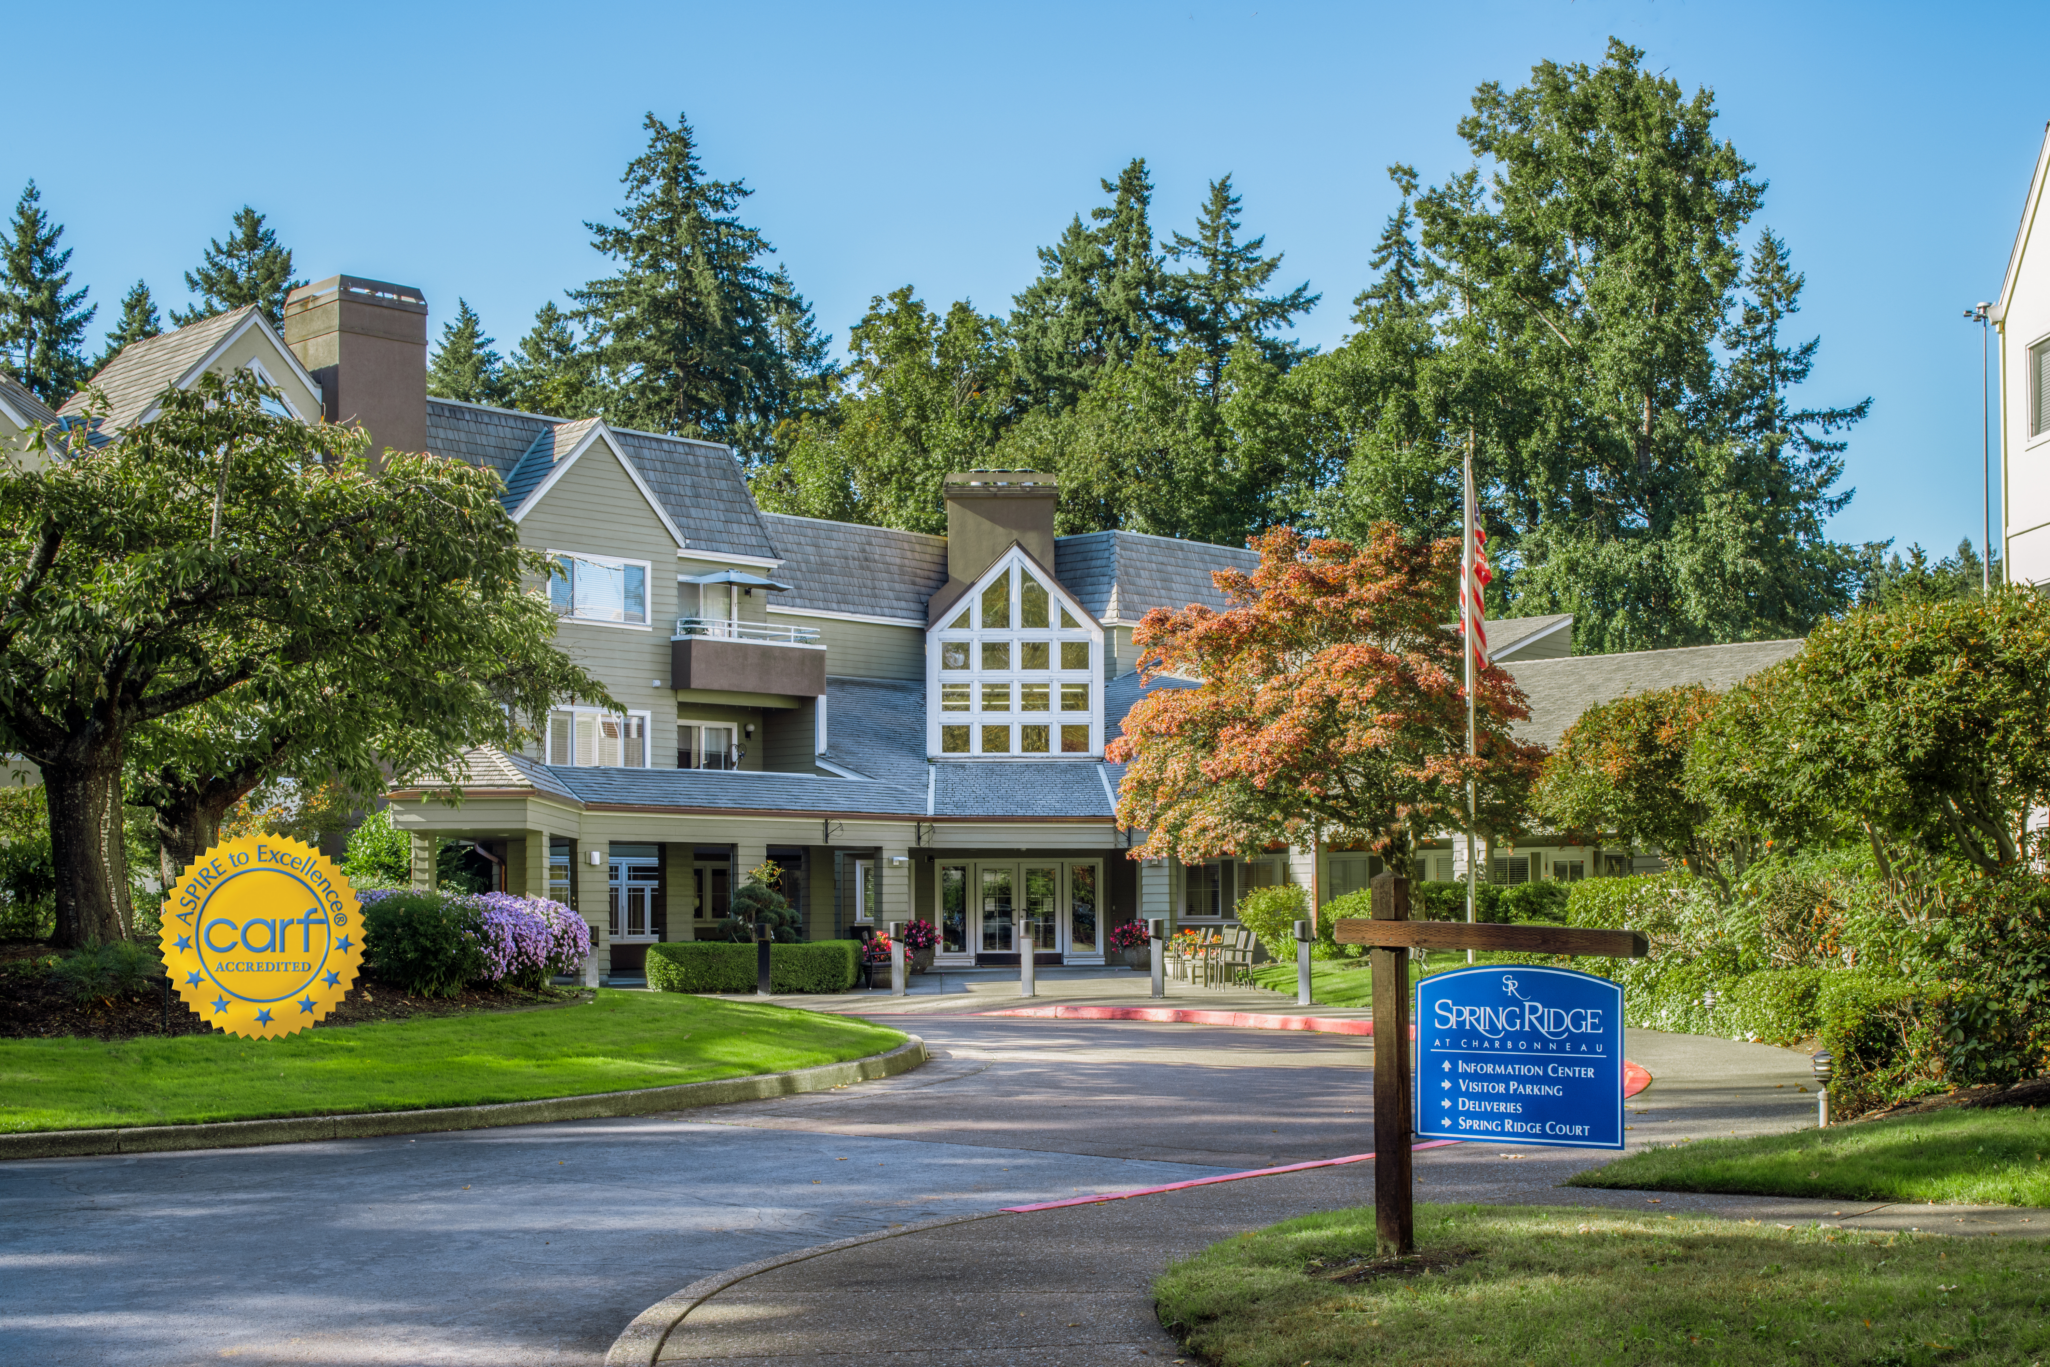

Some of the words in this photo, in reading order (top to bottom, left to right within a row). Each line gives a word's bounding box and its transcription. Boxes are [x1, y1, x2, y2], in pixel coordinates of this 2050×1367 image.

[1434, 1039, 1450, 1047] AT
[1461, 1039, 1603, 1052] CHARBONNEAU
[1458, 1060, 1543, 1076] INFORMATION
[1548, 1063, 1595, 1078] CENTER
[1458, 1079, 1506, 1094] VISITOR
[1509, 1081, 1563, 1096] PARKING
[1458, 1097, 1523, 1114] DELIVERIES
[1458, 1116, 1501, 1132] SPRING
[1504, 1119, 1542, 1134] RIDGE
[1546, 1121, 1590, 1136] COURT
